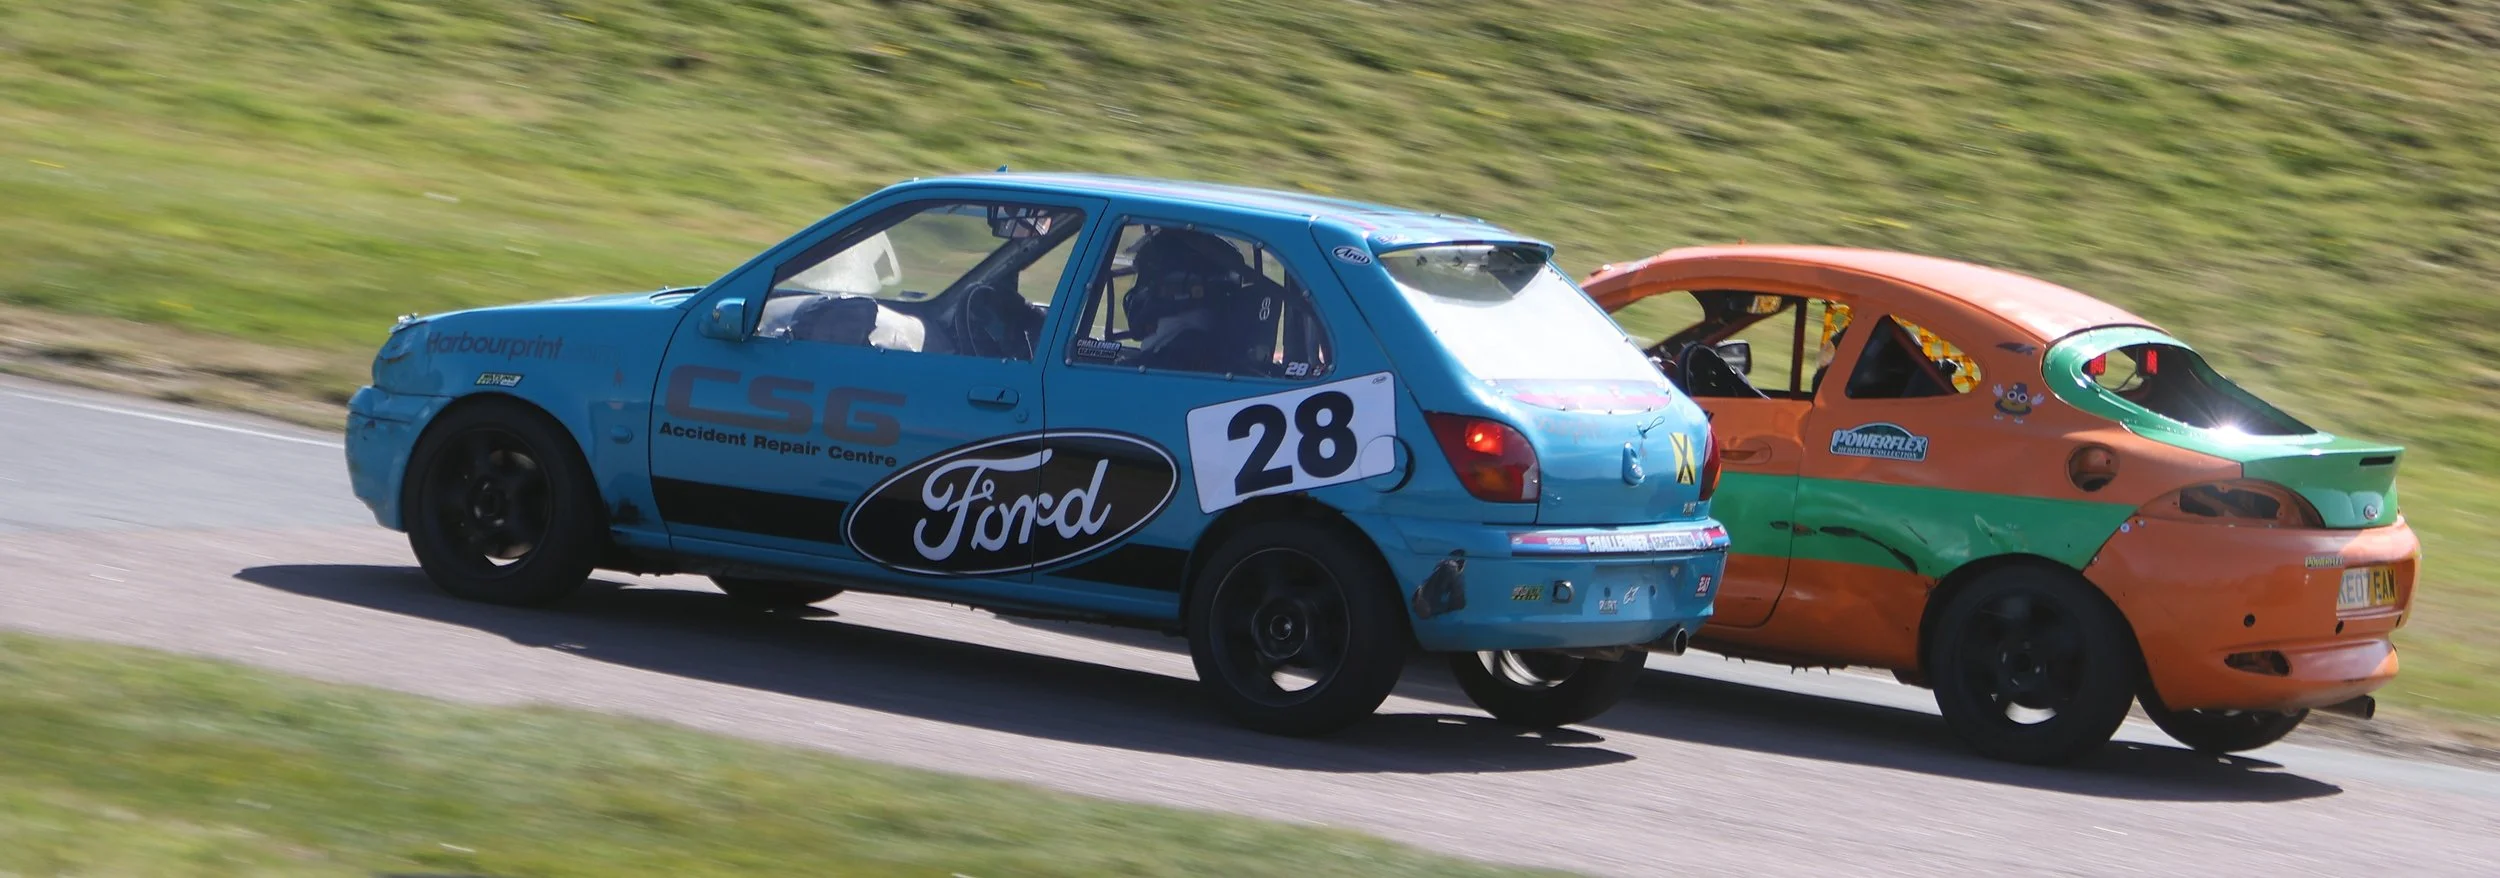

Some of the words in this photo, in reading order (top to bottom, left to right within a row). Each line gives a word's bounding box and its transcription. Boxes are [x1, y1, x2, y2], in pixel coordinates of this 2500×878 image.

[426, 331, 563, 361] Harbourprint
[1285, 361, 1309, 377] 28
[664, 364, 907, 448] CSG
[659, 422, 746, 446] Accident
[753, 435, 821, 456] Repair
[828, 445, 897, 468] Centre
[1227, 390, 1358, 497] 28
[1833, 430, 1926, 453] POWERFLEX
[913, 447, 1112, 561] Ford
